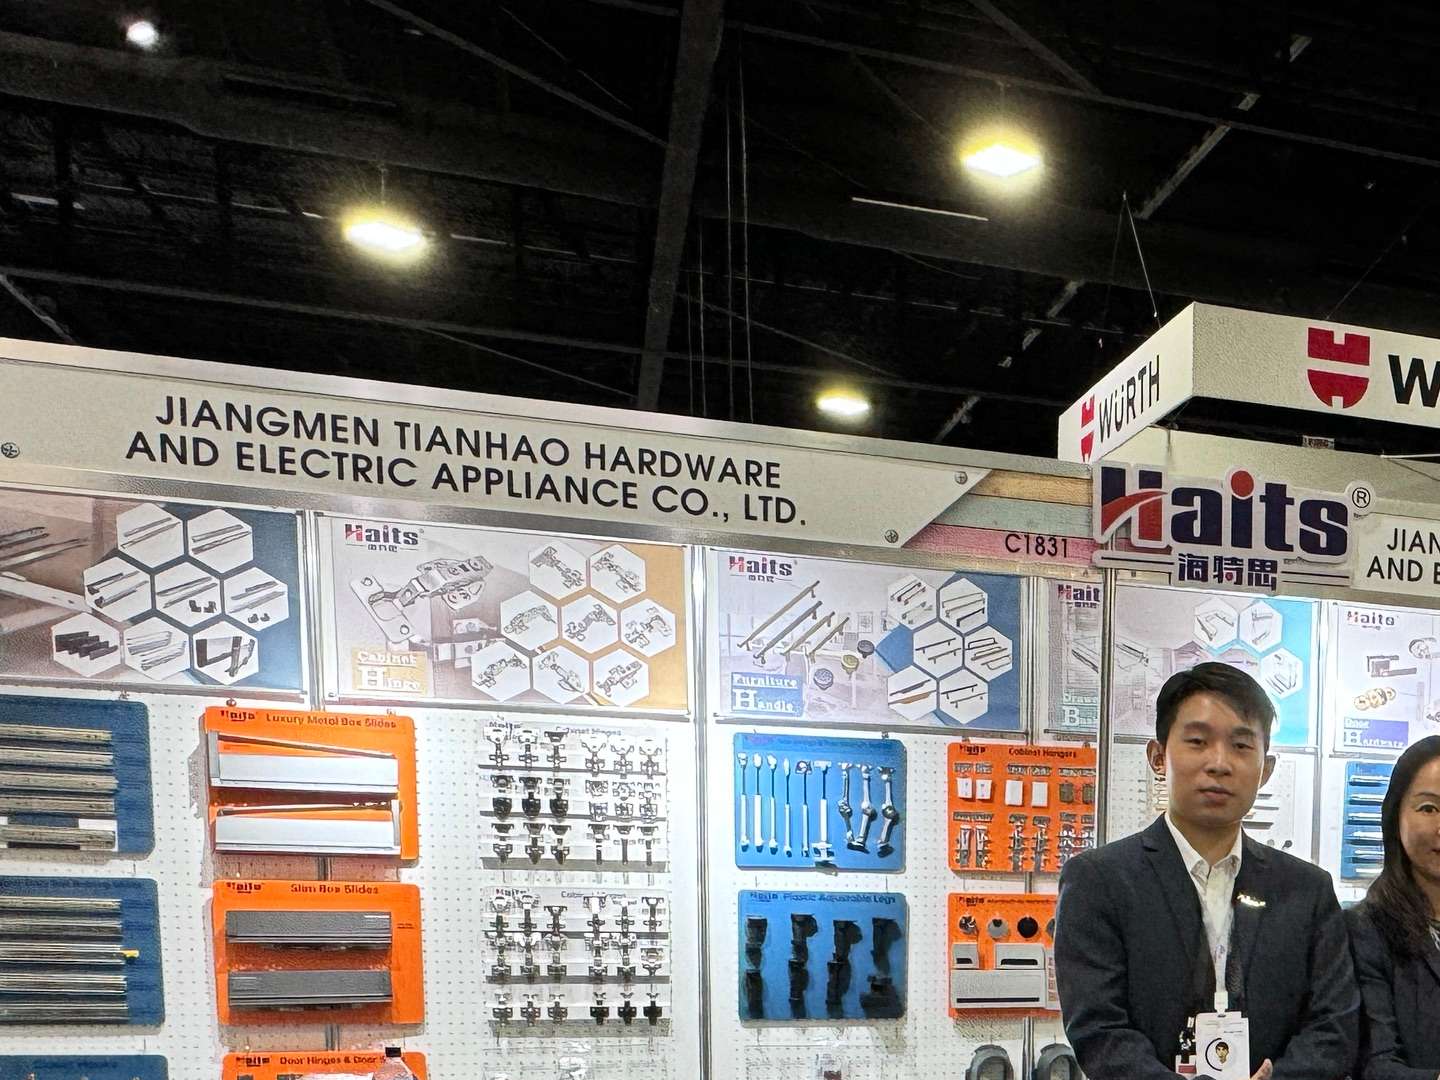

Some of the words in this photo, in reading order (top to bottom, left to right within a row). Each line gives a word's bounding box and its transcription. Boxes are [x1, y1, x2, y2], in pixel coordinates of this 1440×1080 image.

[156, 396, 379, 447] JIANGMEN
[394, 421, 570, 467] TIANHAO
[585, 442, 781, 489] HARDWARE
[126, 431, 219, 467] AND
[236, 441, 417, 488] ELECTRIC
[431, 462, 638, 509] APPLIANCE
[652, 485, 729, 522] CO.,
[744, 493, 806, 526] LTD.
[1101, 466, 1349, 557] Haits
[345, 523, 419, 545] Haits
[1005, 533, 1068, 559] C1831
[729, 555, 793, 577] Haits
[1178, 552, 1279, 591] 海特思
[1366, 556, 1423, 582] AND
[1057, 584, 1101, 602] Hait
[266, 713, 305, 725] Luxury
